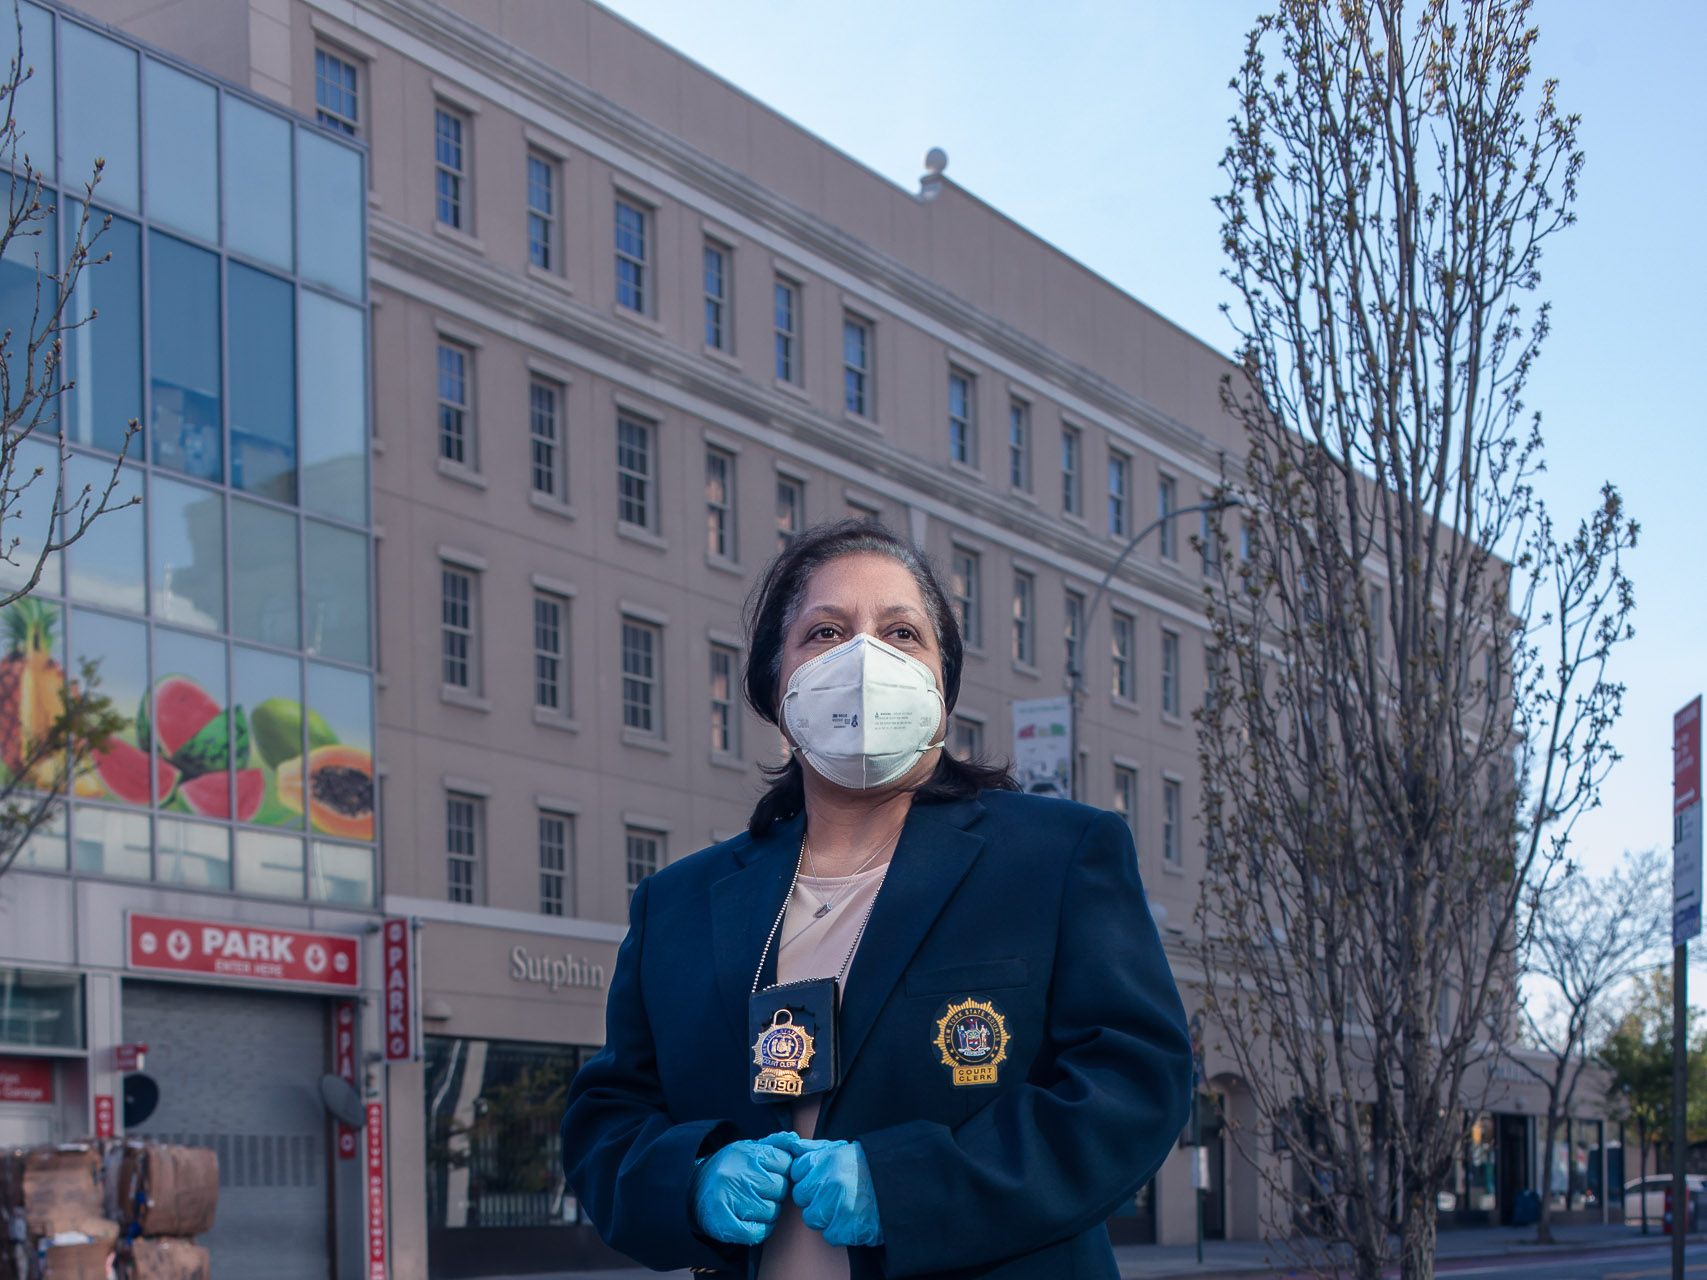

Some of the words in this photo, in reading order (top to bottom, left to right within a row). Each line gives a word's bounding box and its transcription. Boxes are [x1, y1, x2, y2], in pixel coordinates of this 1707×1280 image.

[202, 927, 294, 963] PARK
[511, 944, 604, 991] Sutphin
[389, 946, 405, 1034] PARK
[766, 1030, 779, 1041] YORK
[780, 1028, 797, 1037] STATE
[948, 1013, 964, 1026] YORK
[965, 1009, 985, 1017] STATE
[987, 1015, 1001, 1041] COURTS
[763, 1058, 779, 1067] COURT
[780, 1060, 798, 1068] CLERK
[958, 1067, 993, 1076] COURT
[958, 1074, 992, 1082] CLERK
